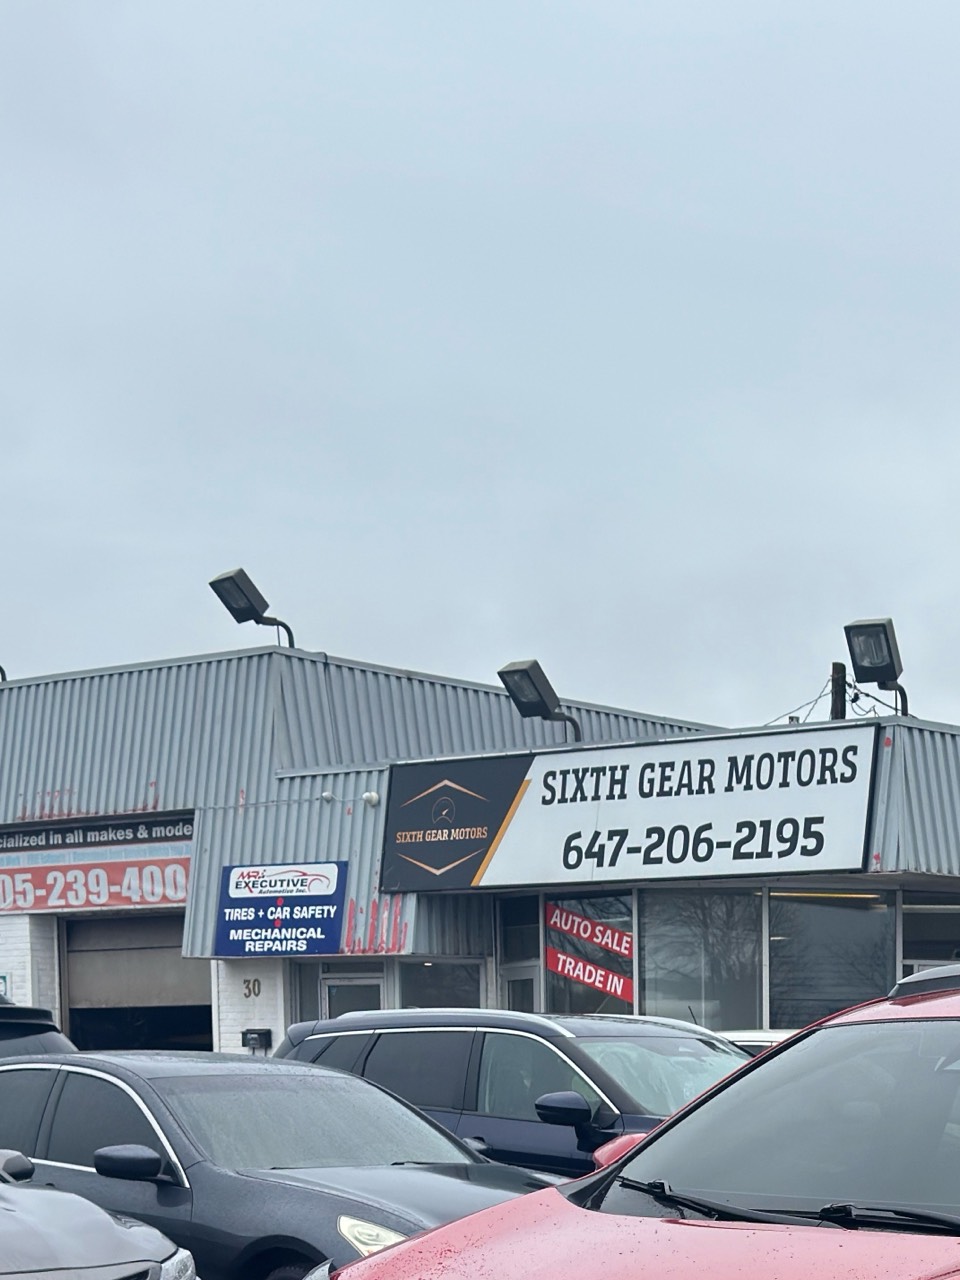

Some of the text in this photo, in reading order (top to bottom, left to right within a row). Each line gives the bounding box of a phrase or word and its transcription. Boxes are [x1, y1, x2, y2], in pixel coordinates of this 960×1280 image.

[541, 745, 859, 806] SIXTH GEAR MOTORS
[49, 831, 62, 846] in
[65, 829, 83, 844] all
[87, 827, 134, 843] makes
[137, 824, 149, 839] &
[396, 827, 488, 843] SIXTH GEAR MOTORS
[562, 816, 825, 870] 647-206-2195
[0, 864, 190, 910] 05-239-400
[235, 878, 309, 893] EXECUTIVE
[224, 905, 337, 921] TIRES + CAR SAFETY
[229, 927, 325, 940] MECHANICAL
[550, 909, 631, 955] AUTO SALE
[245, 940, 307, 952] REPAIRS
[557, 953, 624, 995] TRADE IN
[243, 978, 261, 998] 30
